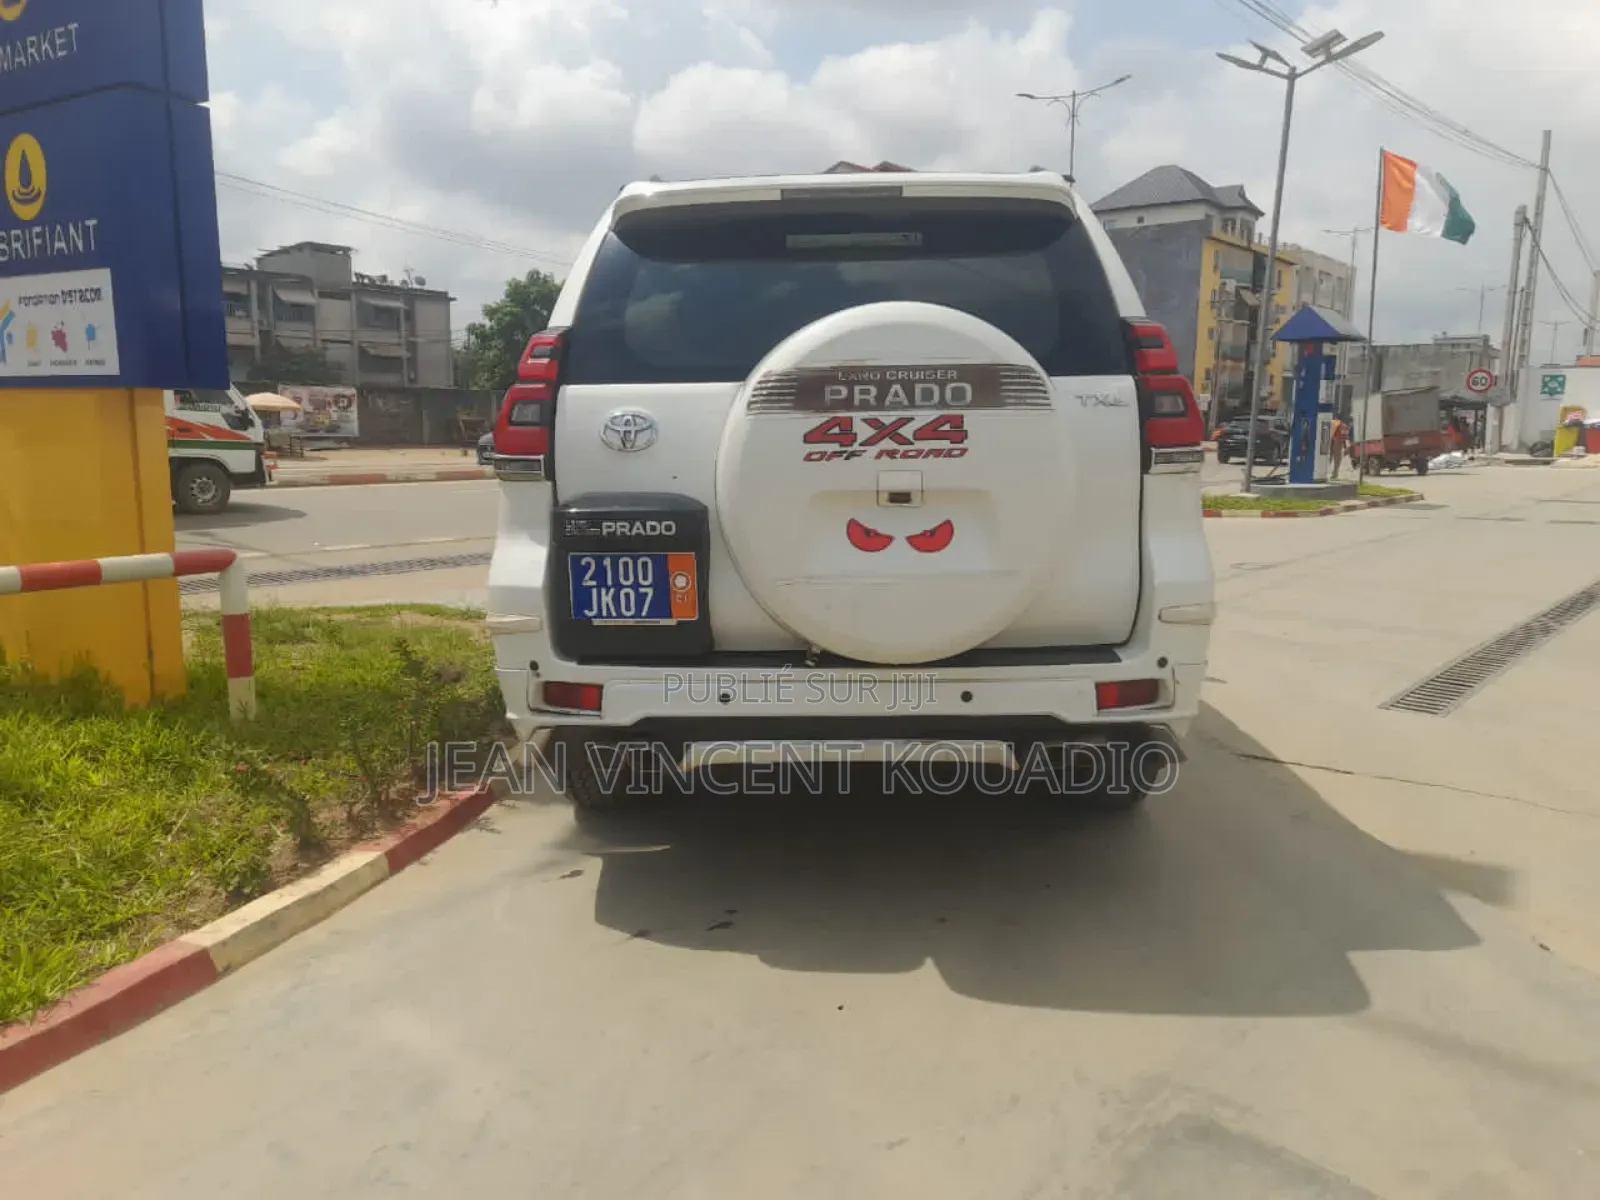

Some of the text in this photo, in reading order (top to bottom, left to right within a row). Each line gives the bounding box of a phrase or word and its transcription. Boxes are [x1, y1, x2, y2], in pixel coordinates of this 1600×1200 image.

[0, 23, 79, 72] MARKET
[886, 369, 958, 380] CRUISER
[1472, 376, 1488, 386] 60
[824, 382, 973, 406] PRADO
[803, 448, 969, 462] OFF ROAD
[601, 521, 676, 536] PRADO
[580, 557, 653, 586] 2100
[584, 588, 654, 617] JK07
